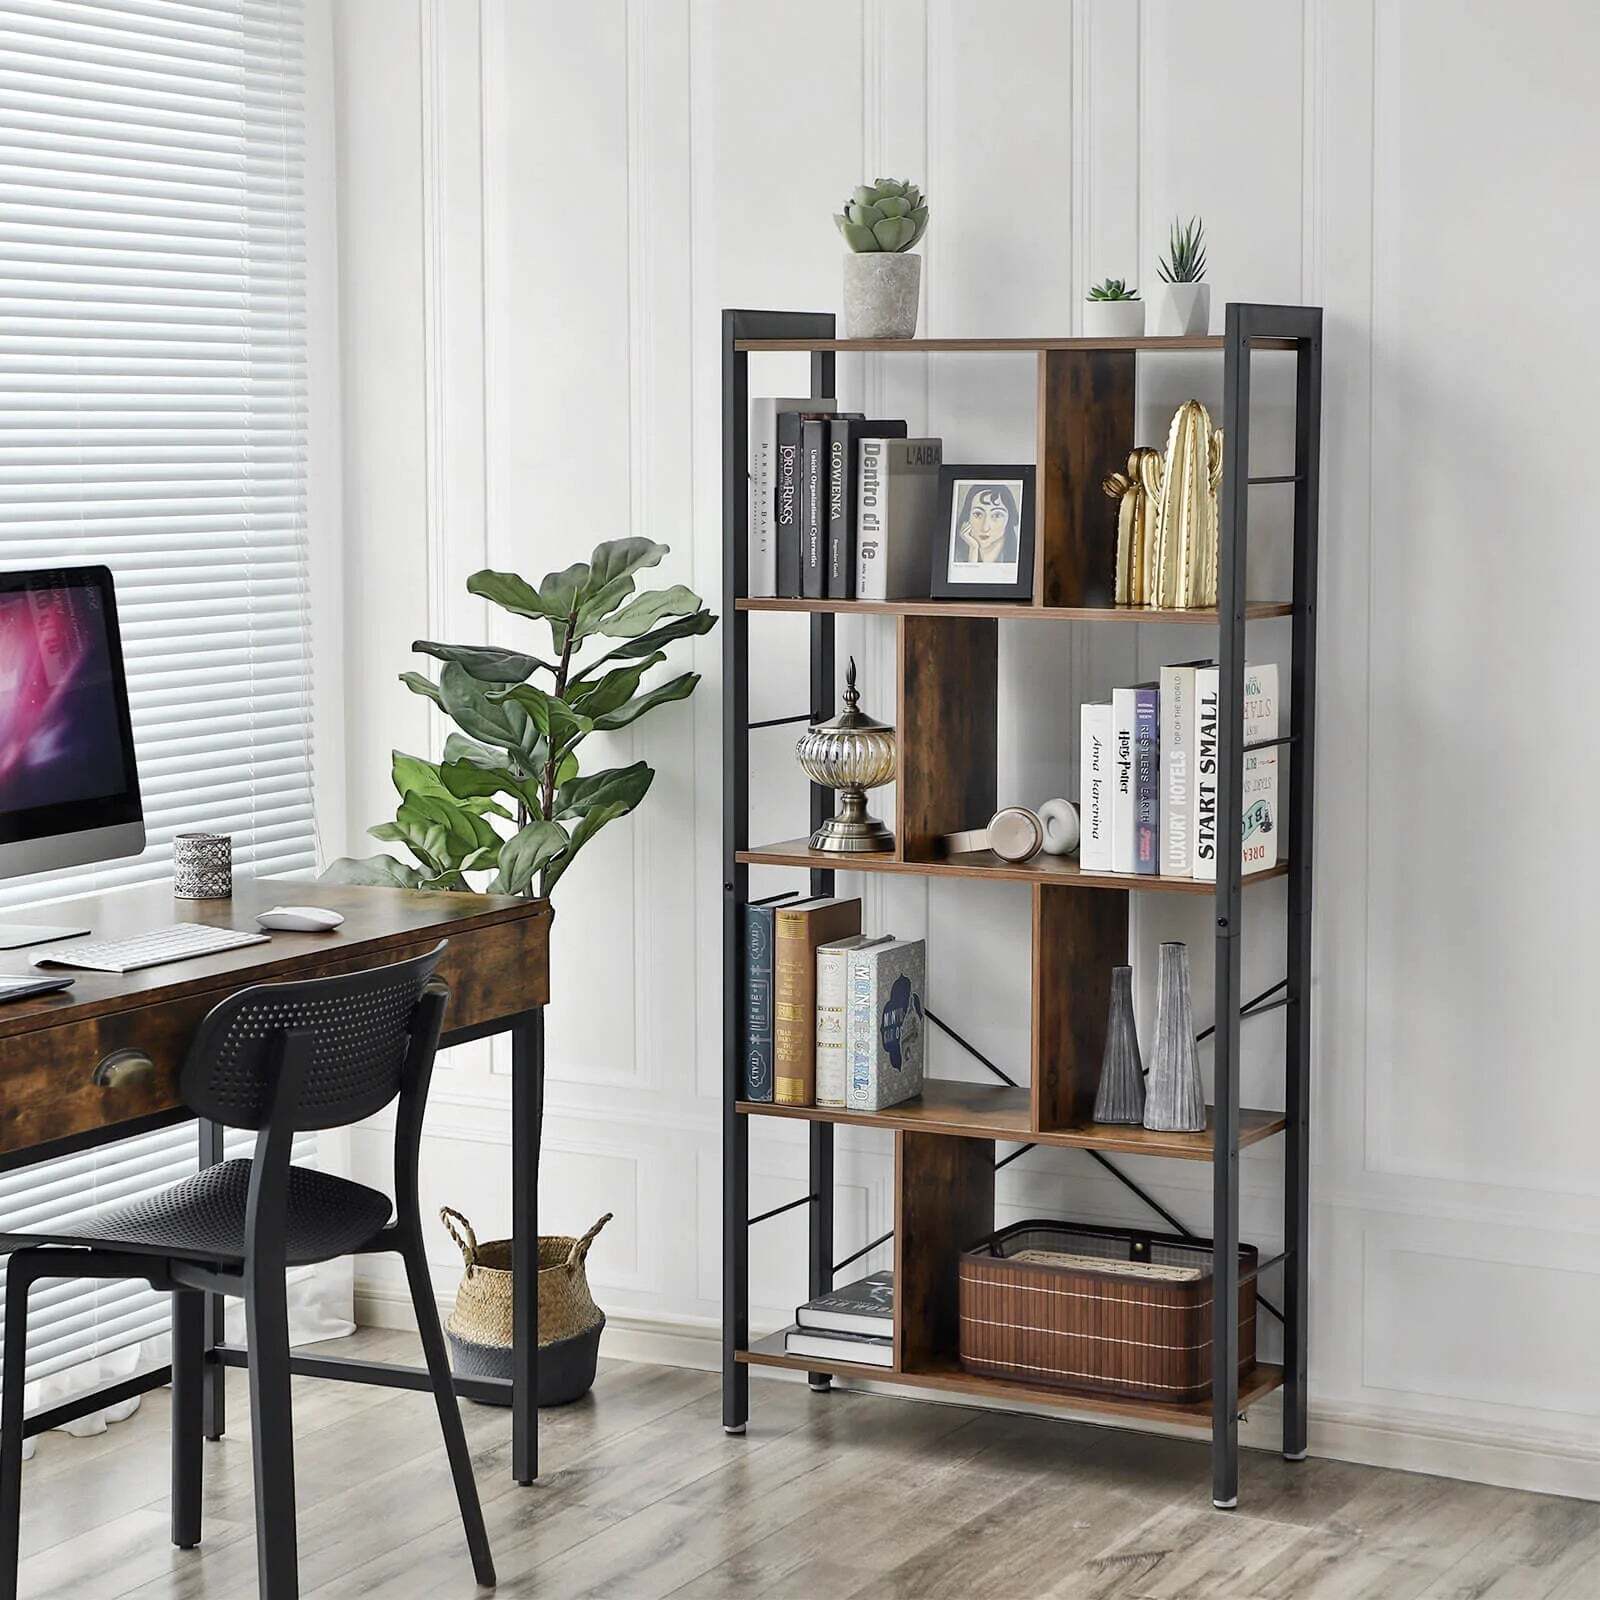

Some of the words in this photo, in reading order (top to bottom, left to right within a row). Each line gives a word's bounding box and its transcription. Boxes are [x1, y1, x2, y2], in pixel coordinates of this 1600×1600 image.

[780, 444, 796, 476] LORD
[863, 443, 881, 507] Dentro
[831, 441, 842, 521] GLOWIENKA
[780, 486, 794, 525] RINGS
[863, 513, 880, 531] di
[808, 527, 818, 567] Cybernetics
[862, 540, 878, 560] te
[1174, 704, 1182, 718] THE
[1174, 720, 1182, 730] OF
[1174, 731, 1182, 745] TOP
[1199, 691, 1217, 774] SMALL
[1092, 735, 1103, 772] Anna
[1140, 724, 1149, 782] RESTLESS
[1116, 761, 1131, 795] Potter
[1169, 750, 1186, 805] HOTELS
[1140, 787, 1150, 823] EARTH
[1198, 782, 1215, 860] START
[1169, 812, 1186, 868] LUXURY
[1243, 846, 1265, 862] DREA
[750, 1055, 760, 1082] ITALY
